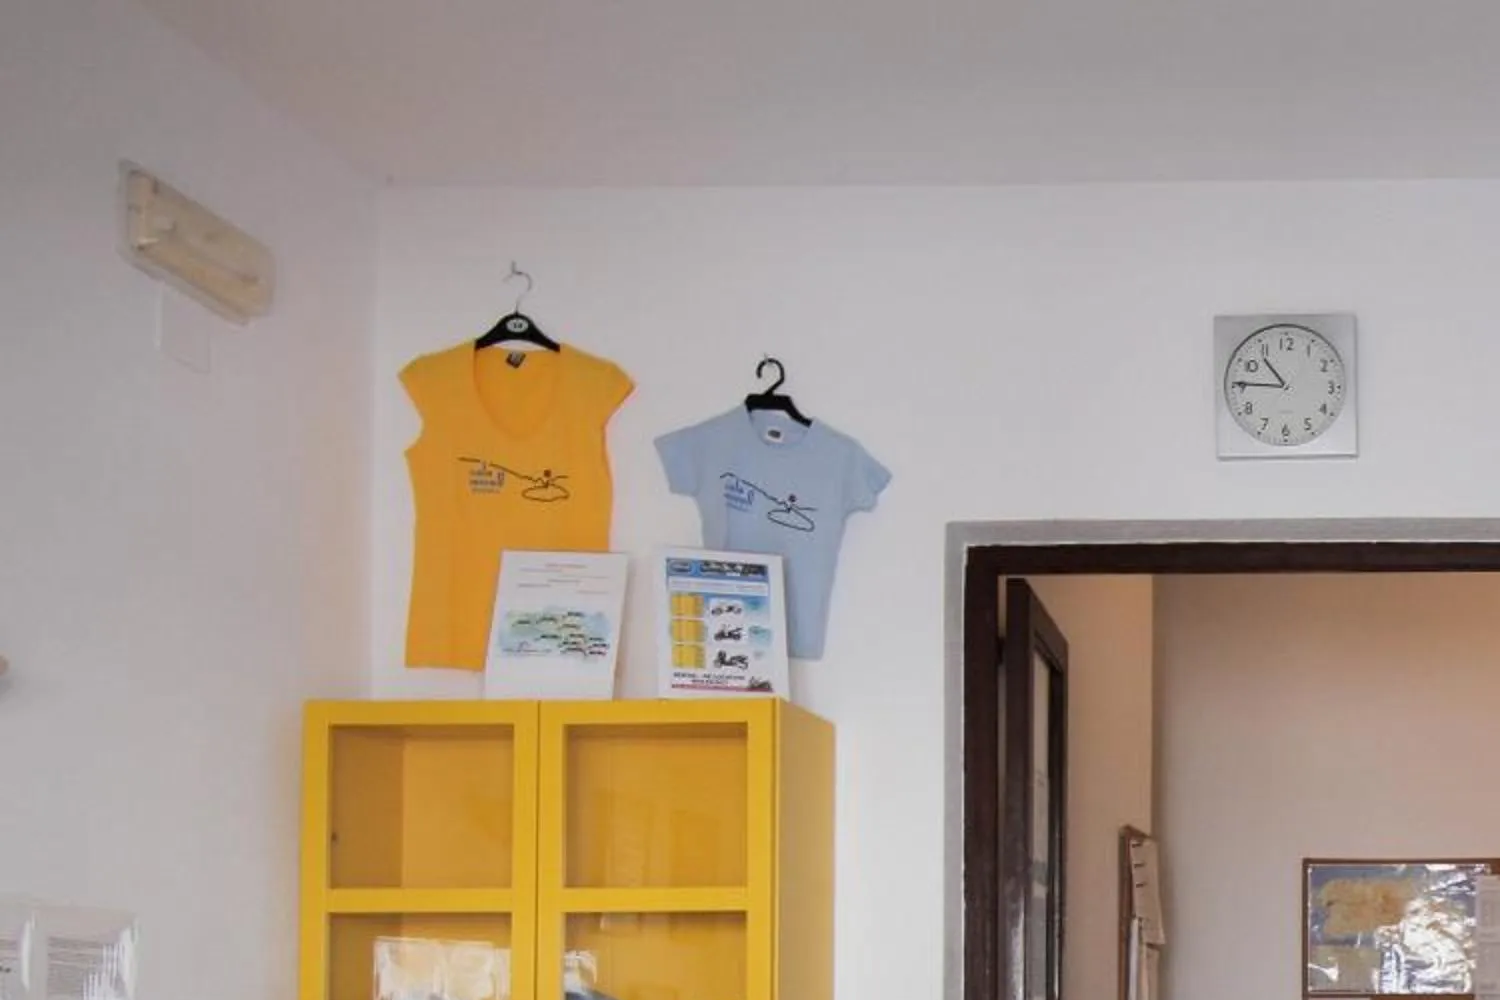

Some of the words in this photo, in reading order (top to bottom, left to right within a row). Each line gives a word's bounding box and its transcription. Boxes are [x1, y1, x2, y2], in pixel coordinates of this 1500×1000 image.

[1279, 337, 1294, 351] 12
[1320, 359, 1328, 373] 2
[1328, 380, 1335, 394] 3
[1244, 402, 1253, 415] 8
[1319, 403, 1327, 415] 4
[1260, 417, 1269, 430] 7
[1304, 417, 1312, 431] 5
[1281, 424, 1290, 437] 6
